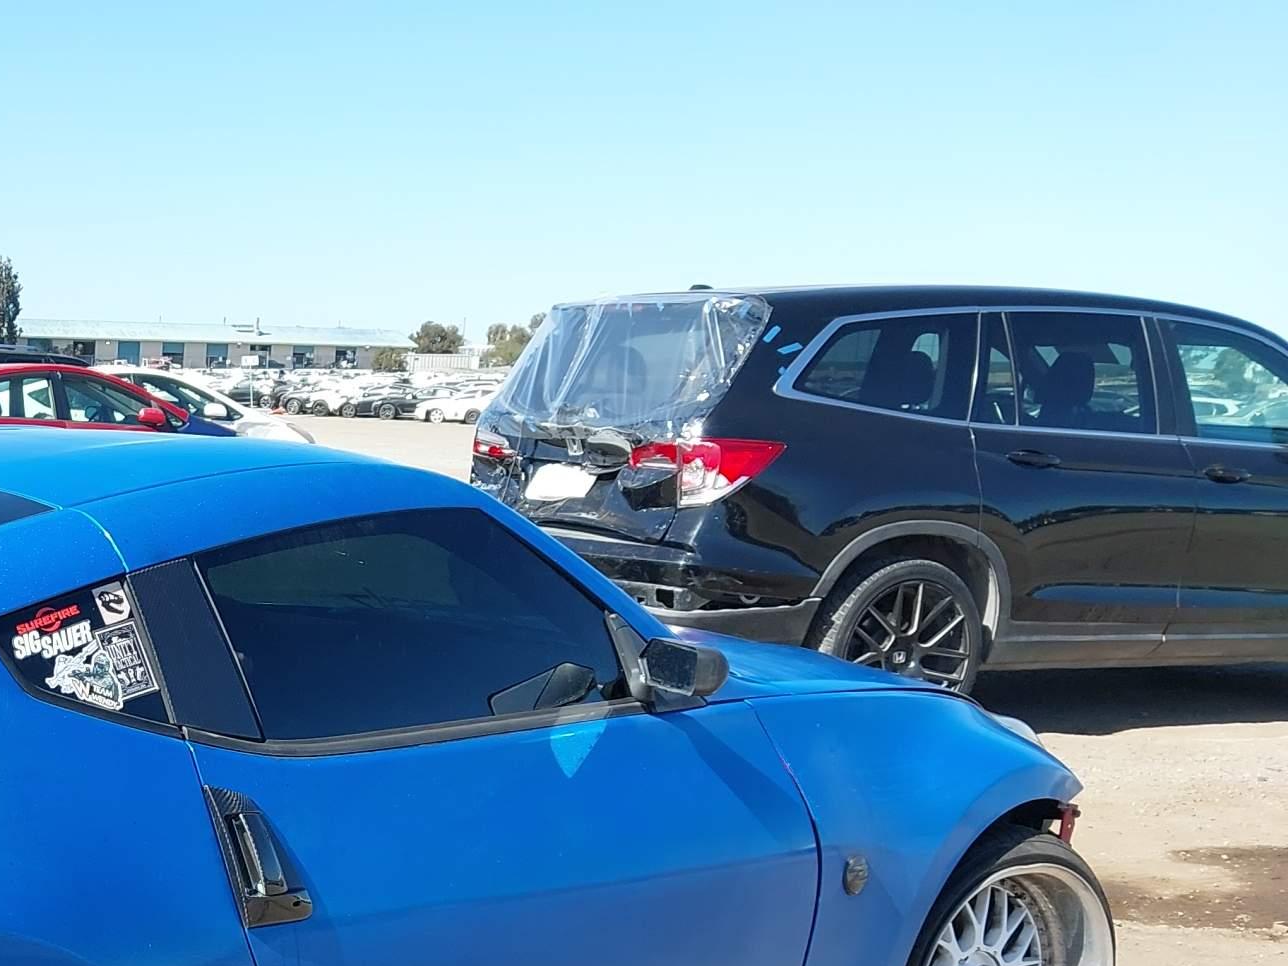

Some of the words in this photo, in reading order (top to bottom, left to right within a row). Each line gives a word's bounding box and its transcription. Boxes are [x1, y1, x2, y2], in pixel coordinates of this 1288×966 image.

[16, 604, 81, 635] SUREFIRE
[12, 629, 43, 660] SIG
[40, 621, 93, 659] SAUER
[105, 638, 139, 661] UNITY
